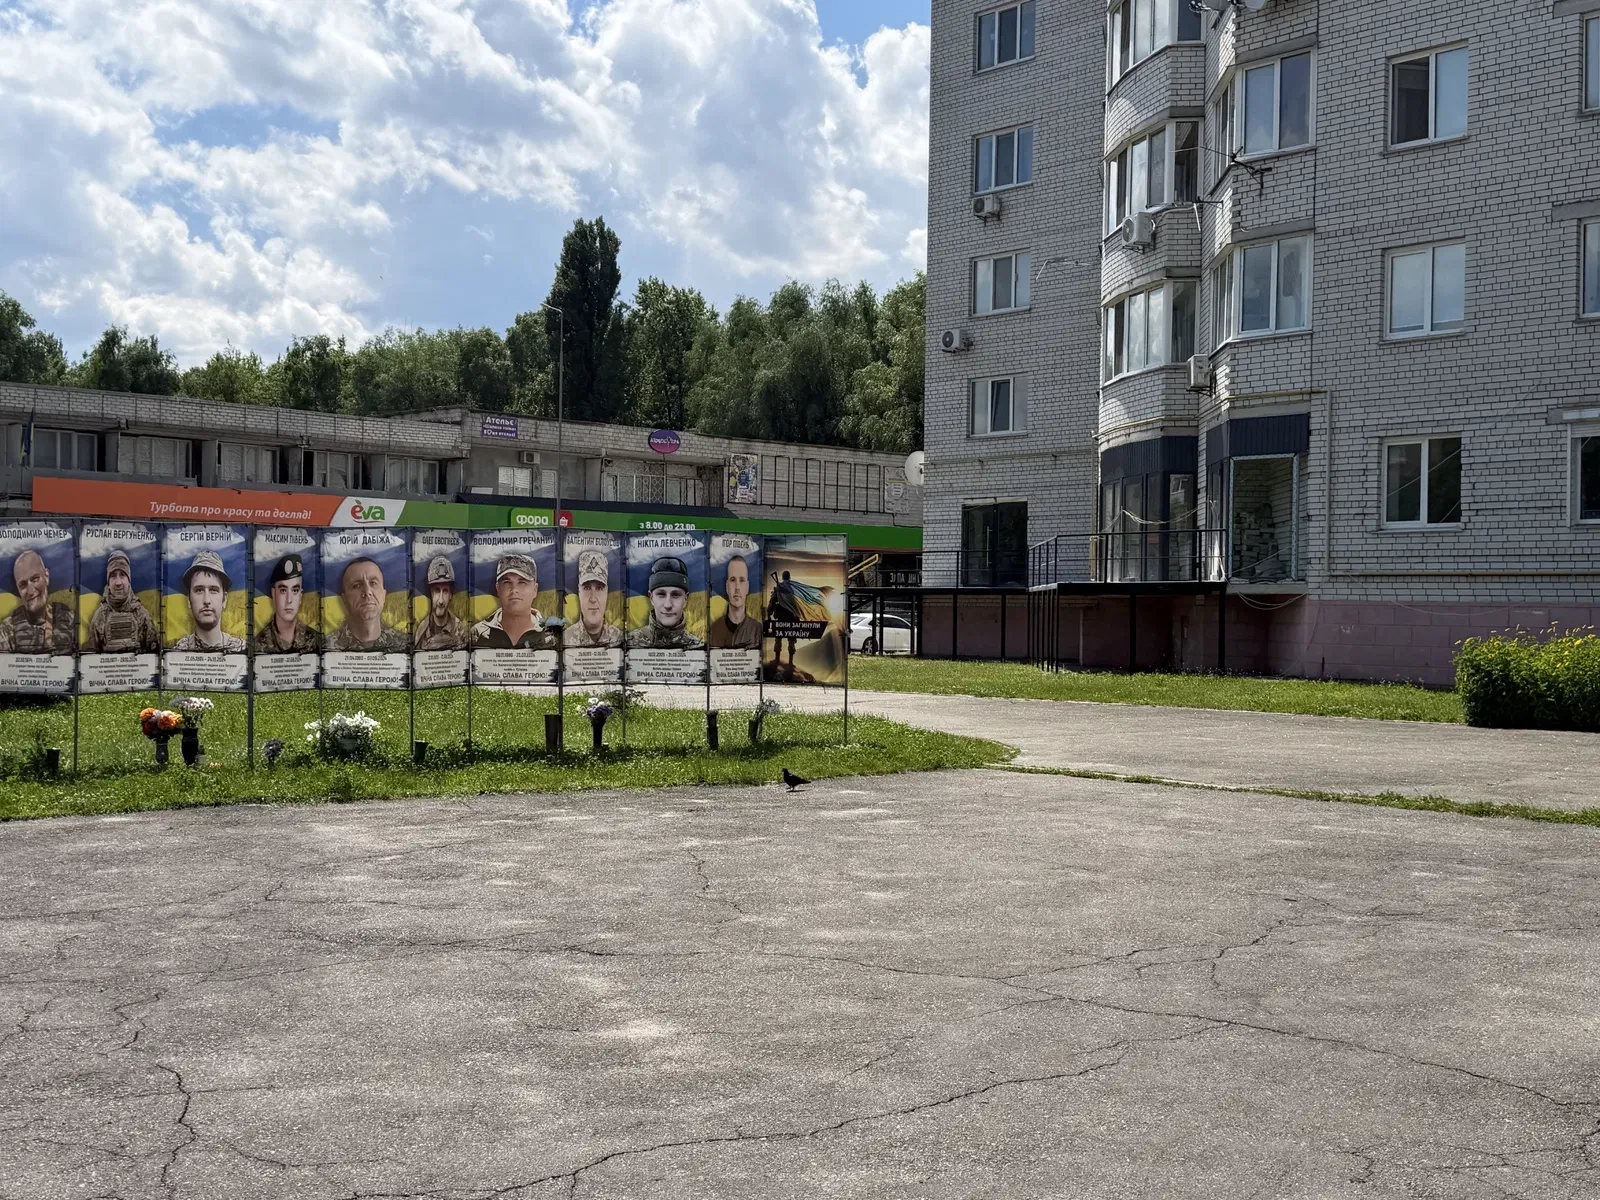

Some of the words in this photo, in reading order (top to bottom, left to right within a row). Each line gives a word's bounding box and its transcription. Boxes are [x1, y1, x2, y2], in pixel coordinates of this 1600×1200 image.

[150, 502, 198, 513] Турбота
[200, 506, 221, 516] про
[223, 508, 254, 518] красу
[255, 510, 270, 518] та
[272, 509, 312, 520] догляд!
[516, 514, 549, 526] фора
[44, 530, 68, 538] ЧЕМЕР
[86, 528, 112, 538] РУСЛАН
[180, 530, 204, 541] СЕРГІЙ
[206, 531, 232, 541] ВЕРНІЙ
[340, 534, 358, 544] ЮРІЙ
[362, 536, 390, 545] ДАБІЖА
[473, 536, 518, 546] ВОЛОДИМИР
[638, 540, 659, 548] НІКІТА
[660, 539, 696, 548] ЛЕВЧЕНКО
